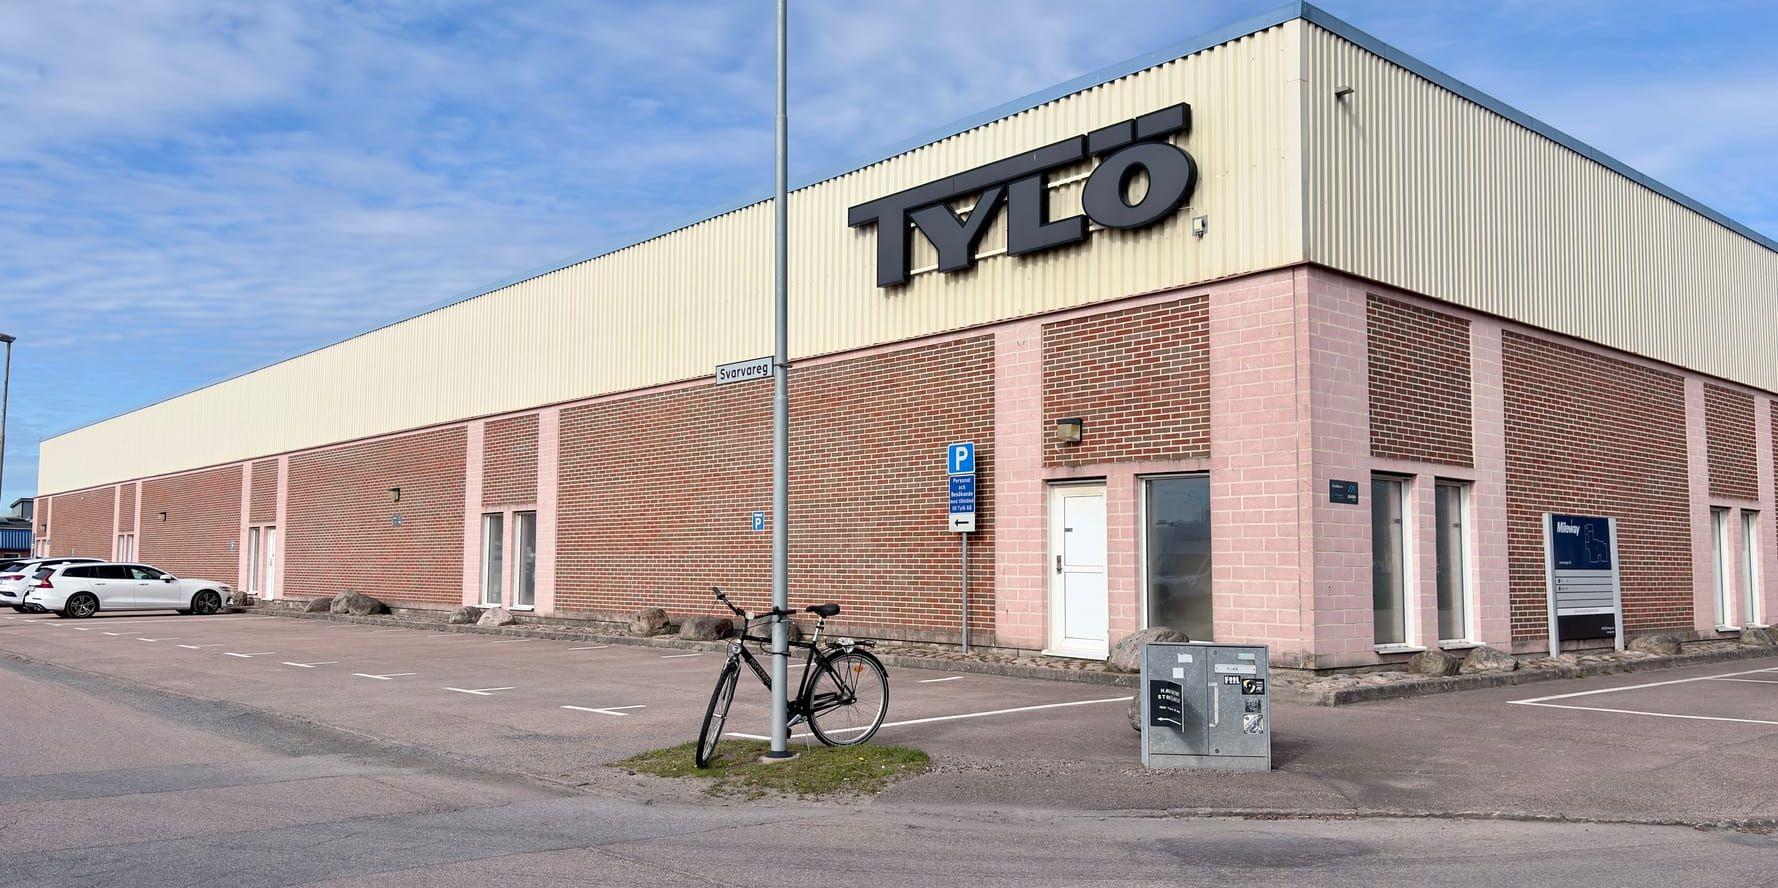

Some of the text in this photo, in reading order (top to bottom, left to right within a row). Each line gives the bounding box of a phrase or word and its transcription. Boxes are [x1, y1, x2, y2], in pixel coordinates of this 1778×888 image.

[848, 102, 1198, 288] TYLÖ
[720, 364, 768, 380] Svarvareg
[956, 446, 968, 471] P
[755, 518, 761, 529] P
[1557, 520, 1580, 536] Mileway
